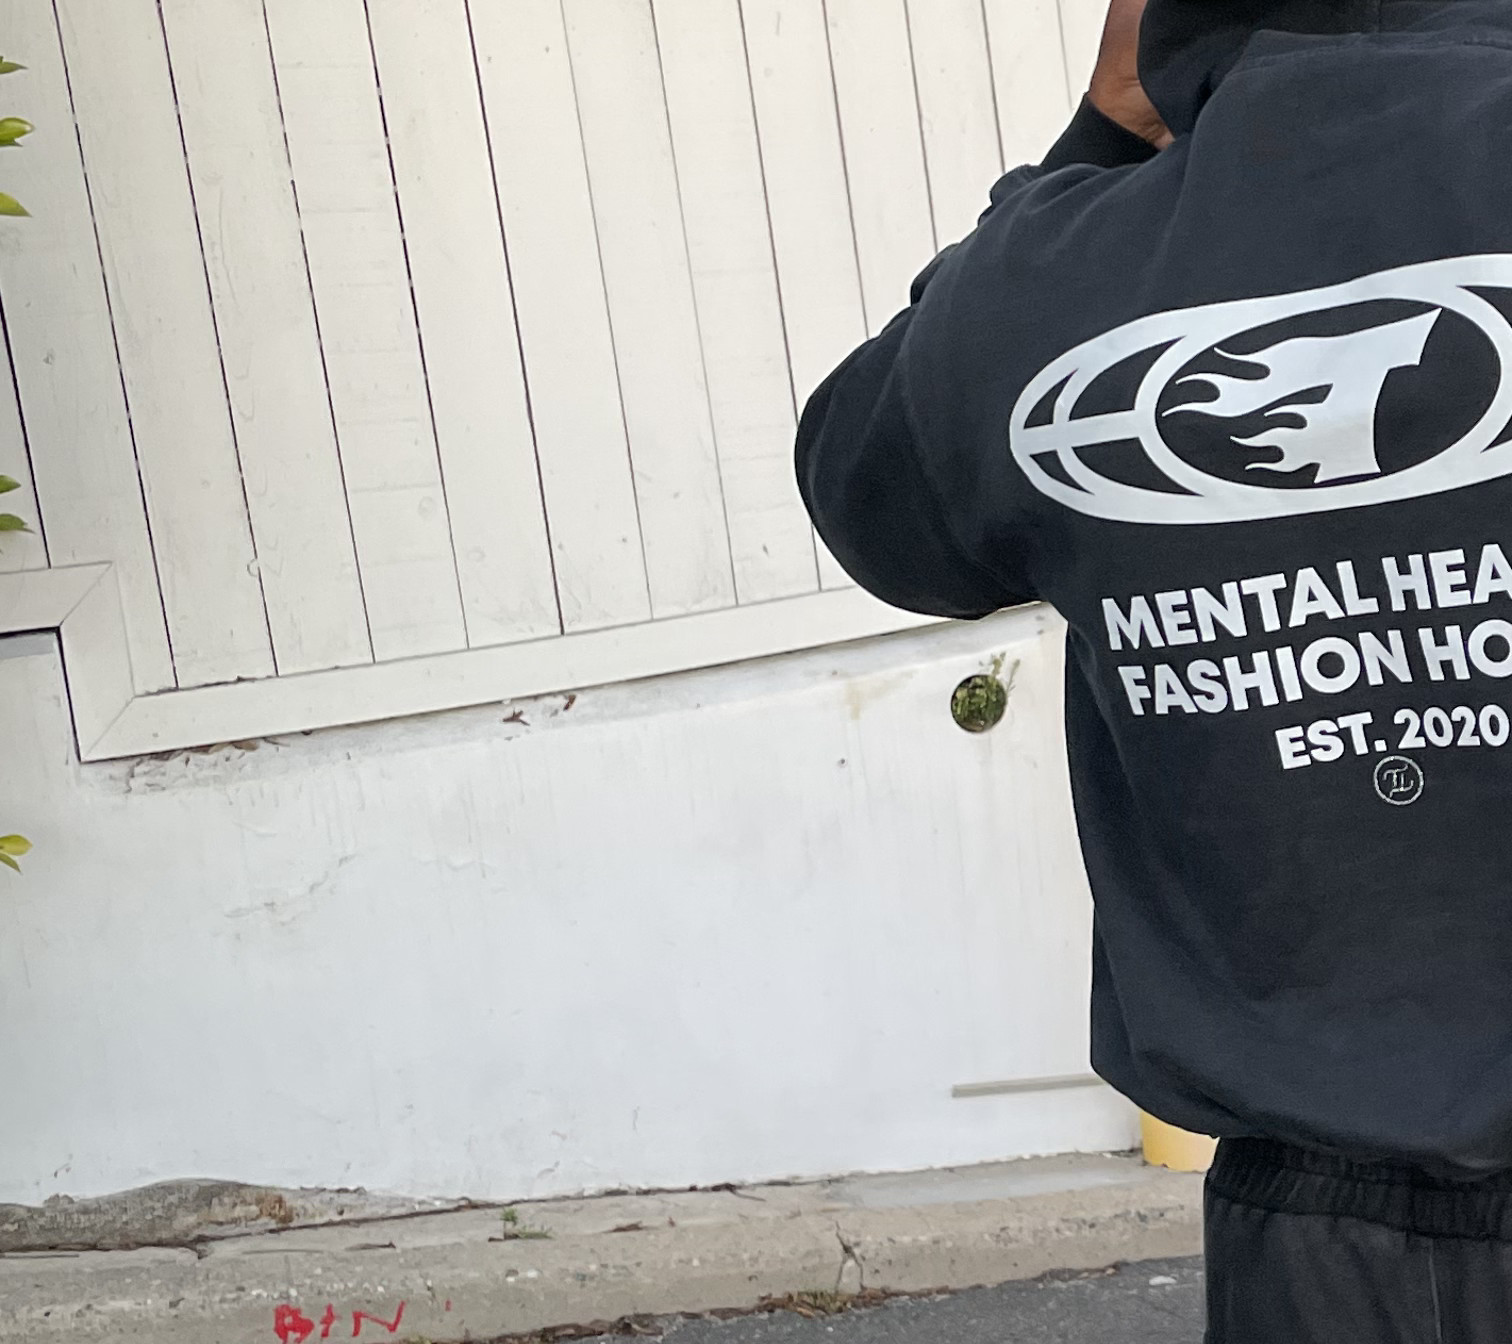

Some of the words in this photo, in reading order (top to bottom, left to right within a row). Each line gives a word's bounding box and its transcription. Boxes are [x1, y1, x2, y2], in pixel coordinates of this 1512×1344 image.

[1102, 560, 1380, 650] MENTAL
[1118, 630, 1412, 715] FASHION
[1275, 712, 1387, 769] EST.
[1394, 704, 1510, 749] 2020
